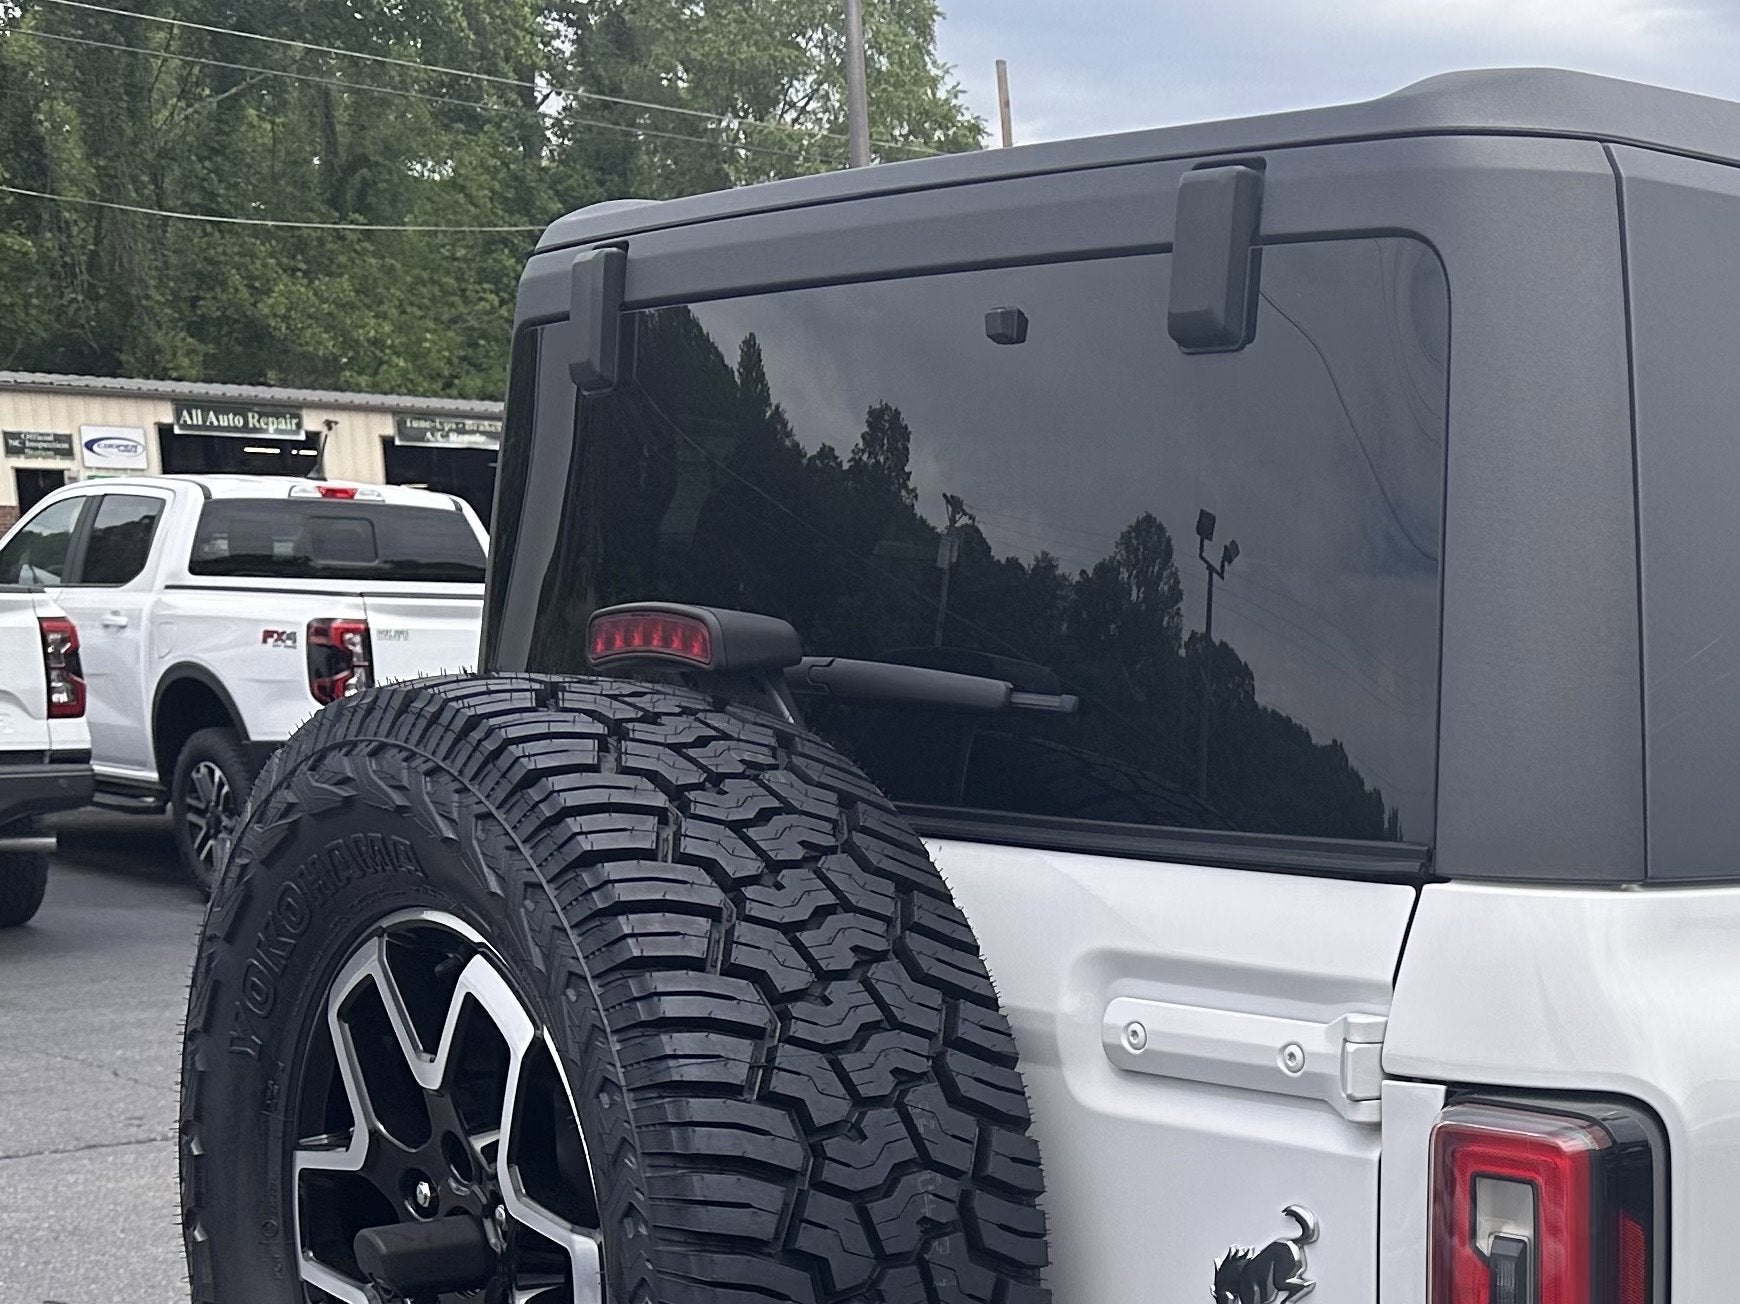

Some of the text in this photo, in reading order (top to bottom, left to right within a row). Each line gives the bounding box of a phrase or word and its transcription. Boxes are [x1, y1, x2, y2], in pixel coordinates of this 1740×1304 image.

[180, 408, 299, 434] All Auto Repair
[262, 629, 297, 645] FX4
[228, 831, 429, 1060] YOKOHAMA
